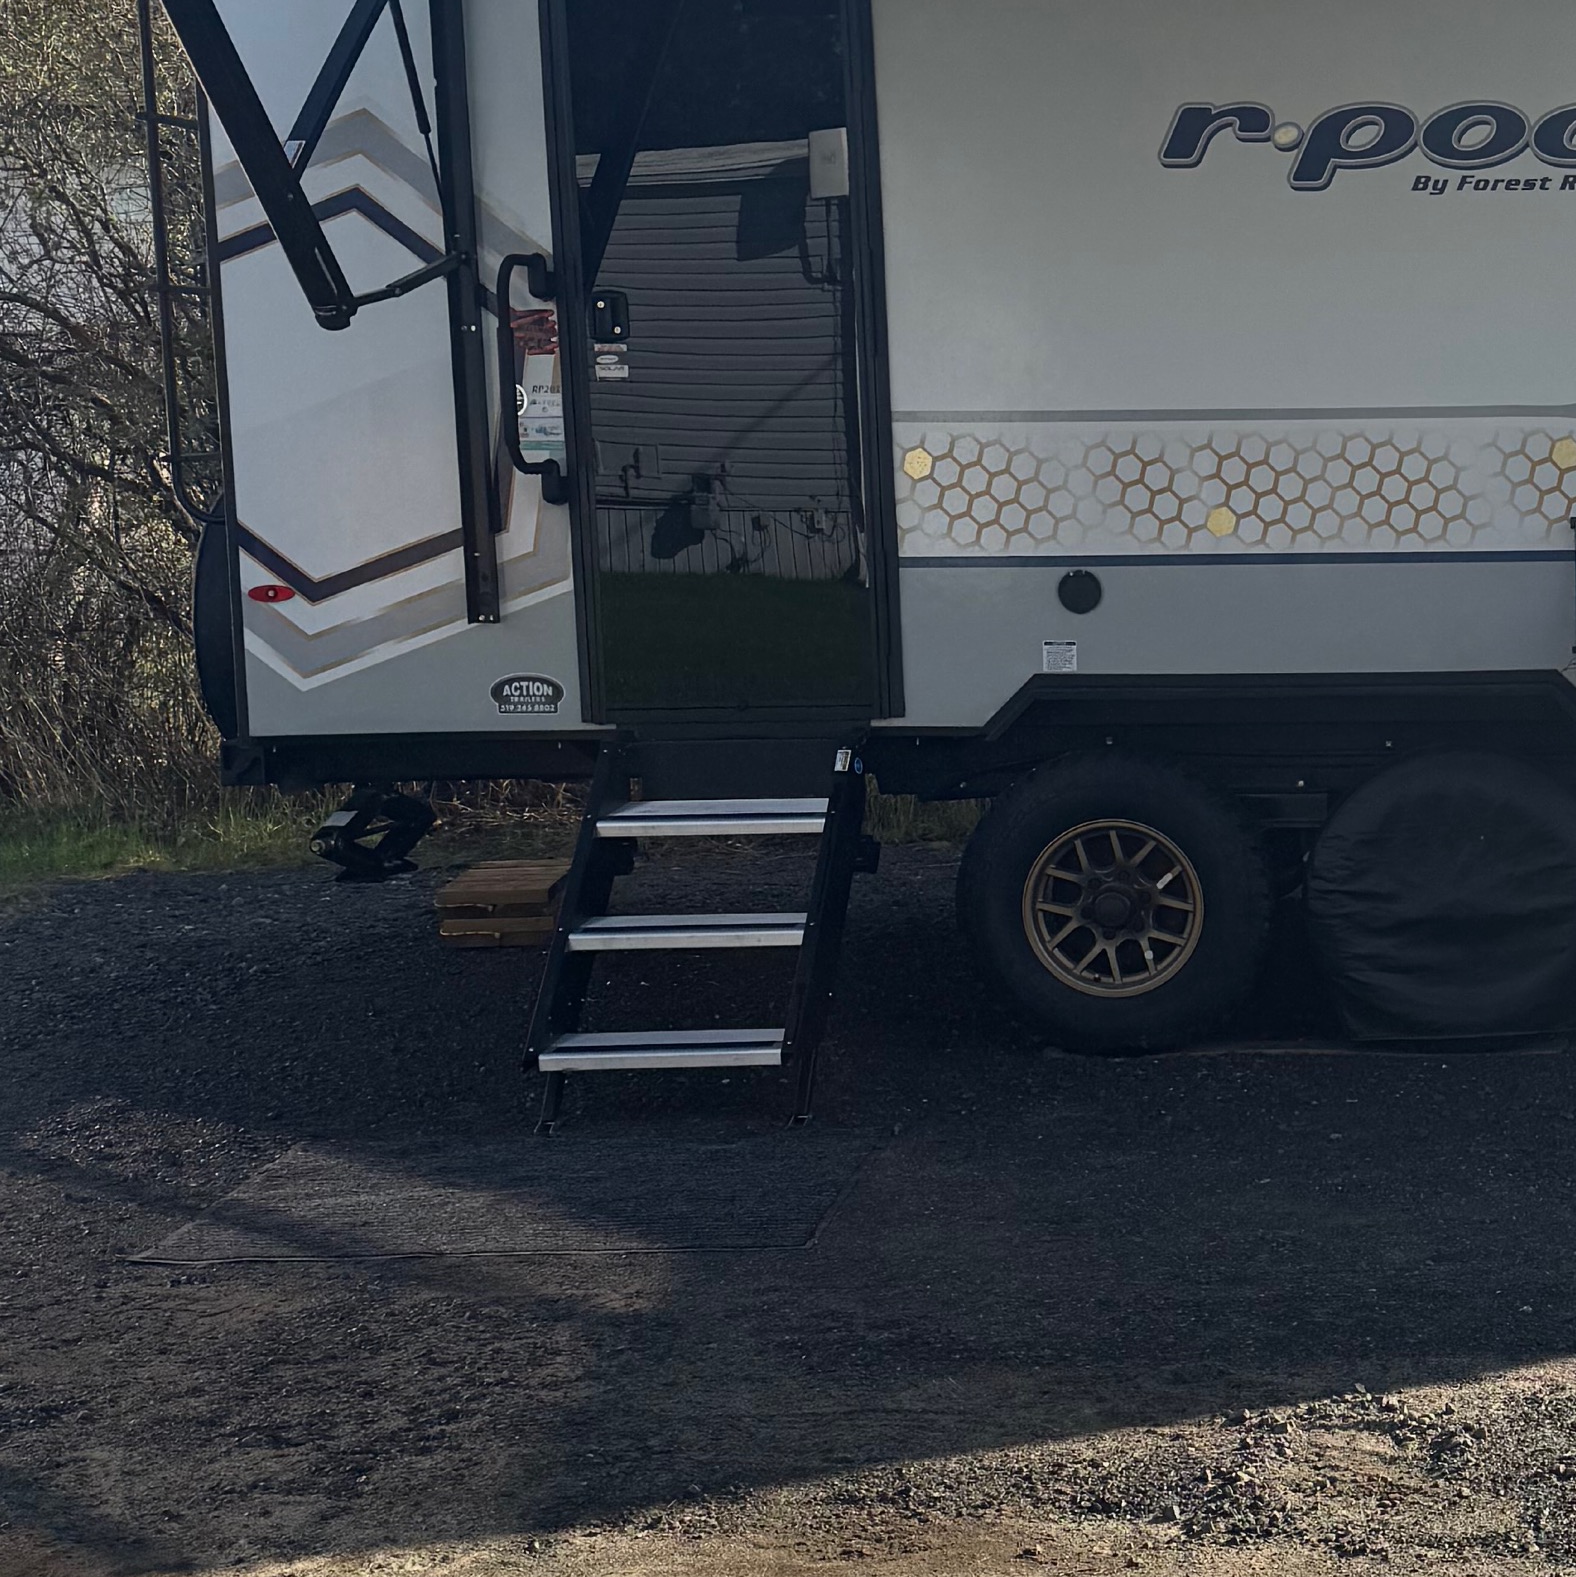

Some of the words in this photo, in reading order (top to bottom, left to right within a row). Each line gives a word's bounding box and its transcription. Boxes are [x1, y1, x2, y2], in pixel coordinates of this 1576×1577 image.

[1410, 175, 1449, 195] By
[1456, 175, 1552, 191] Forest
[502, 681, 553, 696] ACTION
